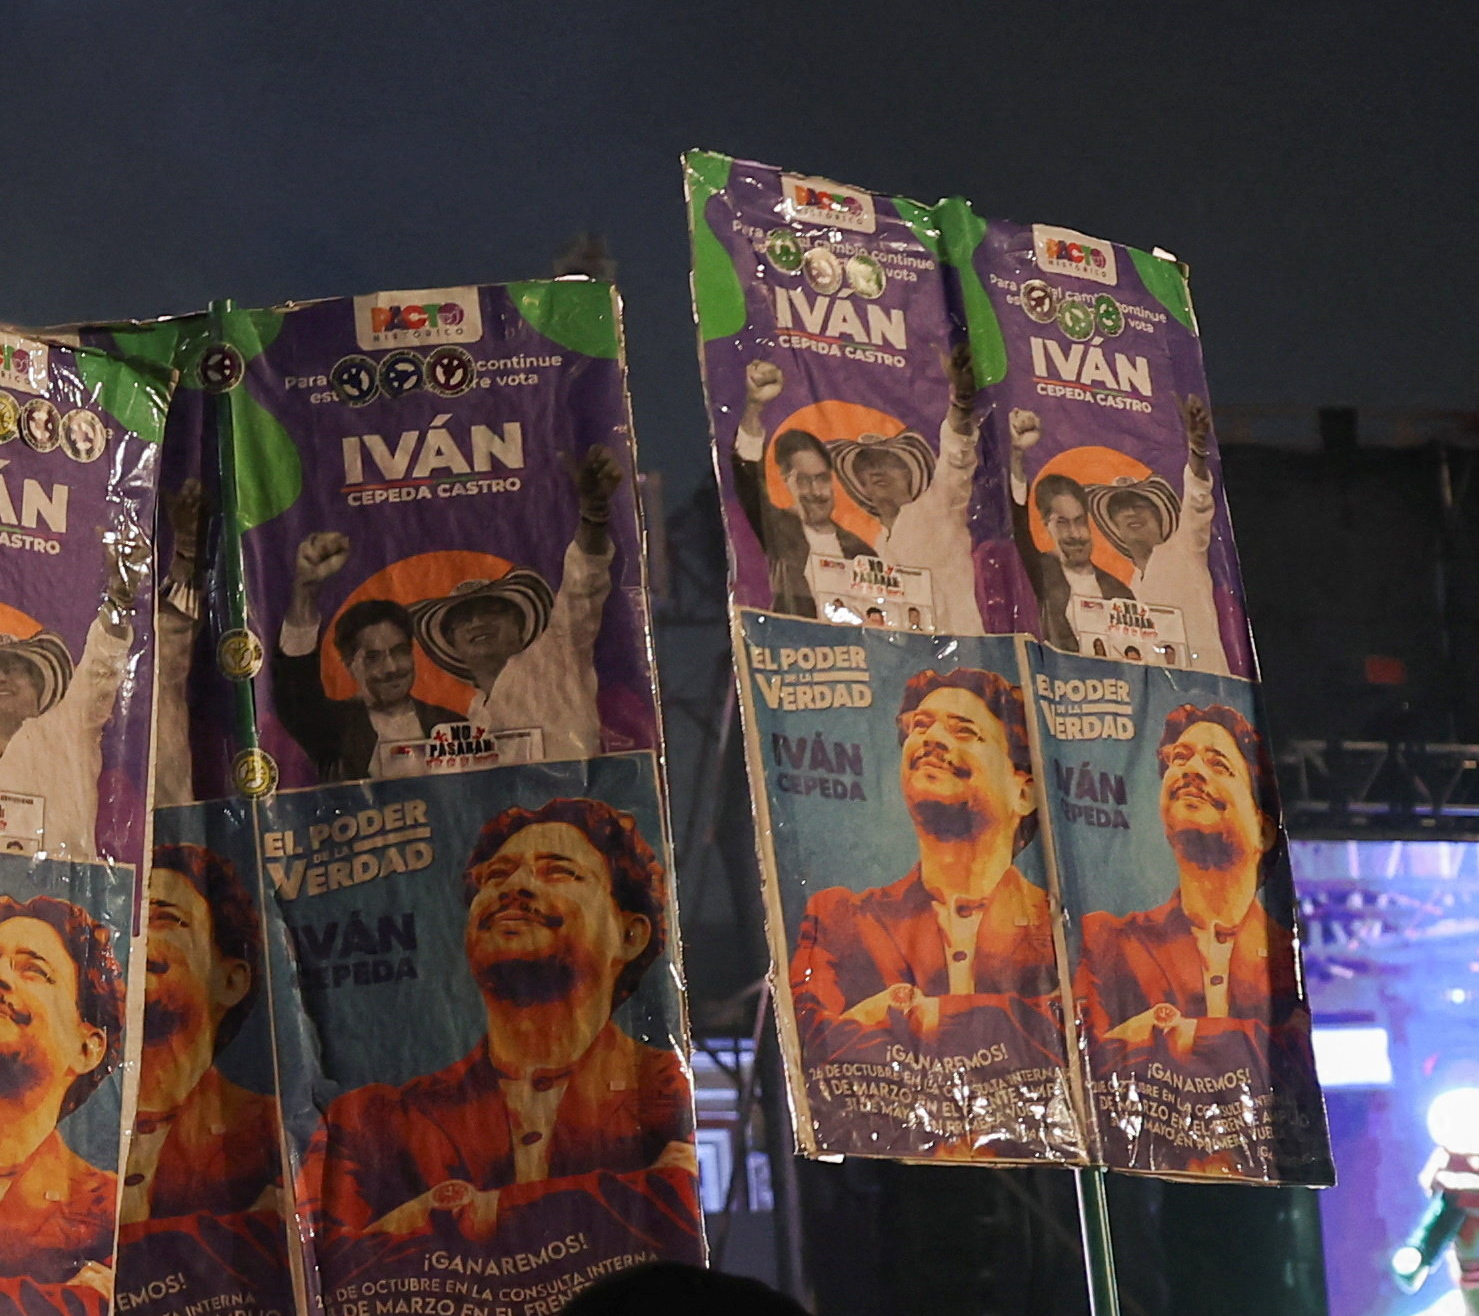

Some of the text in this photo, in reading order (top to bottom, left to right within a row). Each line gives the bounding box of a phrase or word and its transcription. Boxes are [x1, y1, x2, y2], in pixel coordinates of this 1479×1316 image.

[990, 274, 1017, 291] Para
[774, 286, 907, 350] IVÁN
[1129, 318, 1154, 334] vota
[779, 335, 906, 368] CEPEDA CASTRO
[1030, 336, 1152, 397] IVÁN
[284, 375, 328, 390] Para
[497, 372, 539, 387] vota
[1037, 383, 1152, 413] CEPEDA CASTRO
[342, 414, 524, 485] IVÁN
[347, 477, 522, 507] CEPEDA CASTRO
[751, 646, 868, 671] EL PODER
[755, 672, 872, 711] VERDAD
[1055, 679, 1131, 703] PODER
[450, 725, 471, 741] NO
[1040, 700, 1135, 741] VERDAD
[772, 731, 863, 776] IVÁN
[263, 799, 428, 858] EL PODER
[265, 842, 434, 902] VERDAD
[887, 1043, 1009, 1075] ¡GANAREMOS!
[1147, 1062, 1252, 1094] ¡GANAREMOS!
[424, 1232, 588, 1277] ¡GANAREMOS!
[336, 1251, 658, 1303] DE OCTUBRE EN LA CONSULTA INTERNA
